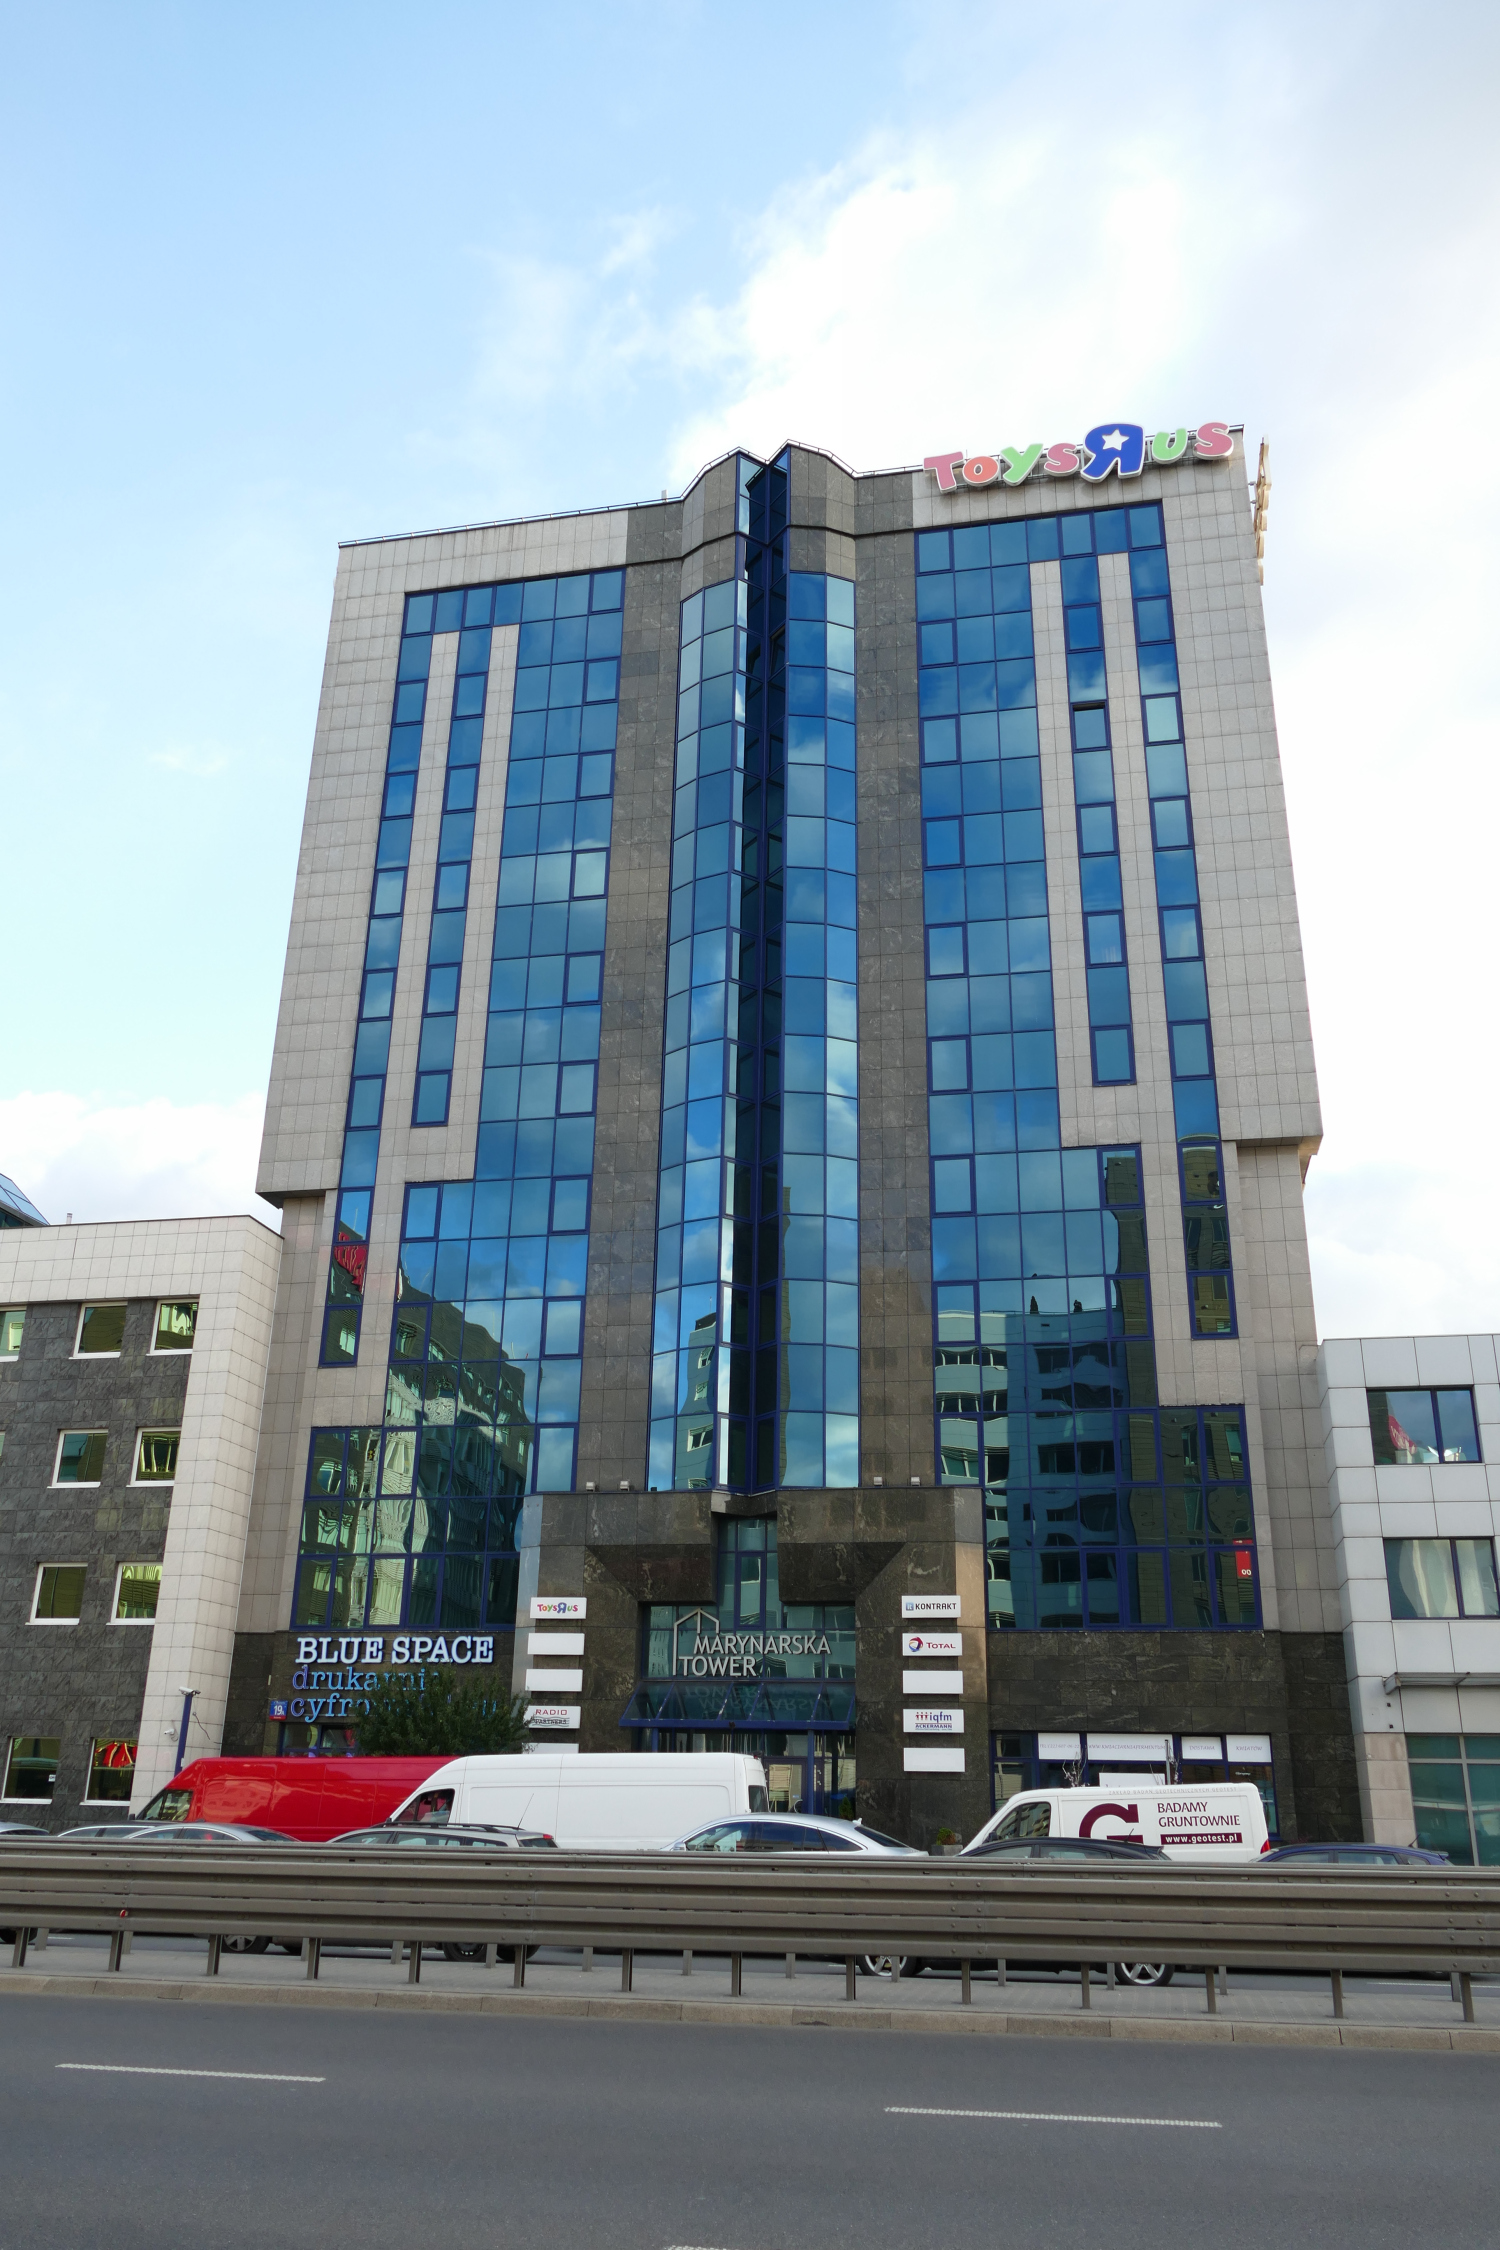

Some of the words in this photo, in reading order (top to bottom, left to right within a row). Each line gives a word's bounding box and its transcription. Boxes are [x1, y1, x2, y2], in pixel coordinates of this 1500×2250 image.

[915, 1602, 957, 1610] KONTRAKT
[295, 1636, 384, 1664] BLUE
[391, 1635, 494, 1664] SPACE
[693, 1635, 832, 1655] MARYNARSKA
[678, 1656, 758, 1677] TOWER
[929, 1711, 952, 1723] iqfm
[1157, 1801, 1208, 1813] BADAMY
[1158, 1815, 1240, 1827] GRUNTOWNIE
[1165, 1833, 1238, 1844] www.geotest.pl
